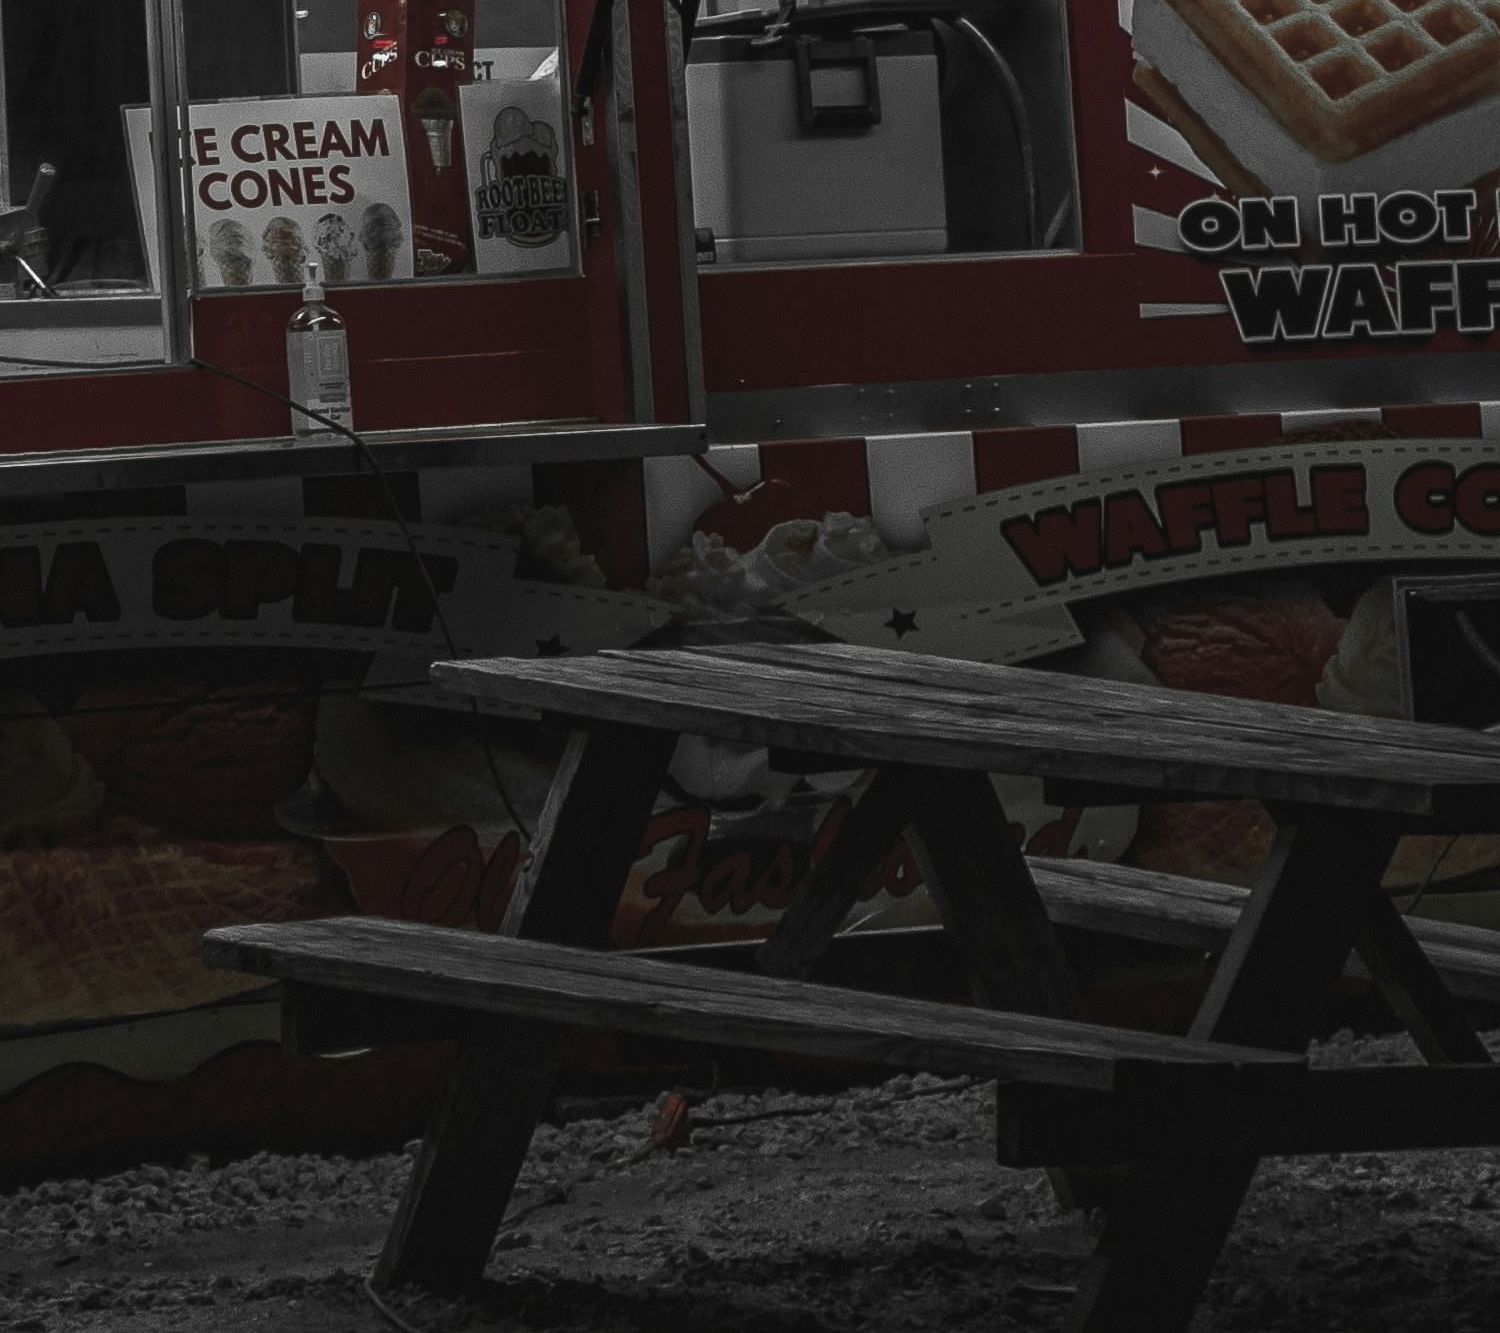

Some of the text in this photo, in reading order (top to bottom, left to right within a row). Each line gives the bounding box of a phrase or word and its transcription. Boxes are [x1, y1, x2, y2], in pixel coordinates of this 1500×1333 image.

[231, 119, 390, 163] CREAM
[198, 165, 356, 211] CONES
[477, 176, 525, 209] ROOT
[1177, 195, 1300, 253] ON
[1321, 190, 1478, 245] HOT
[1002, 464, 1371, 587] WAFFLE
[150, 538, 460, 633] SPLIT
[400, 824, 520, 933] Ol
